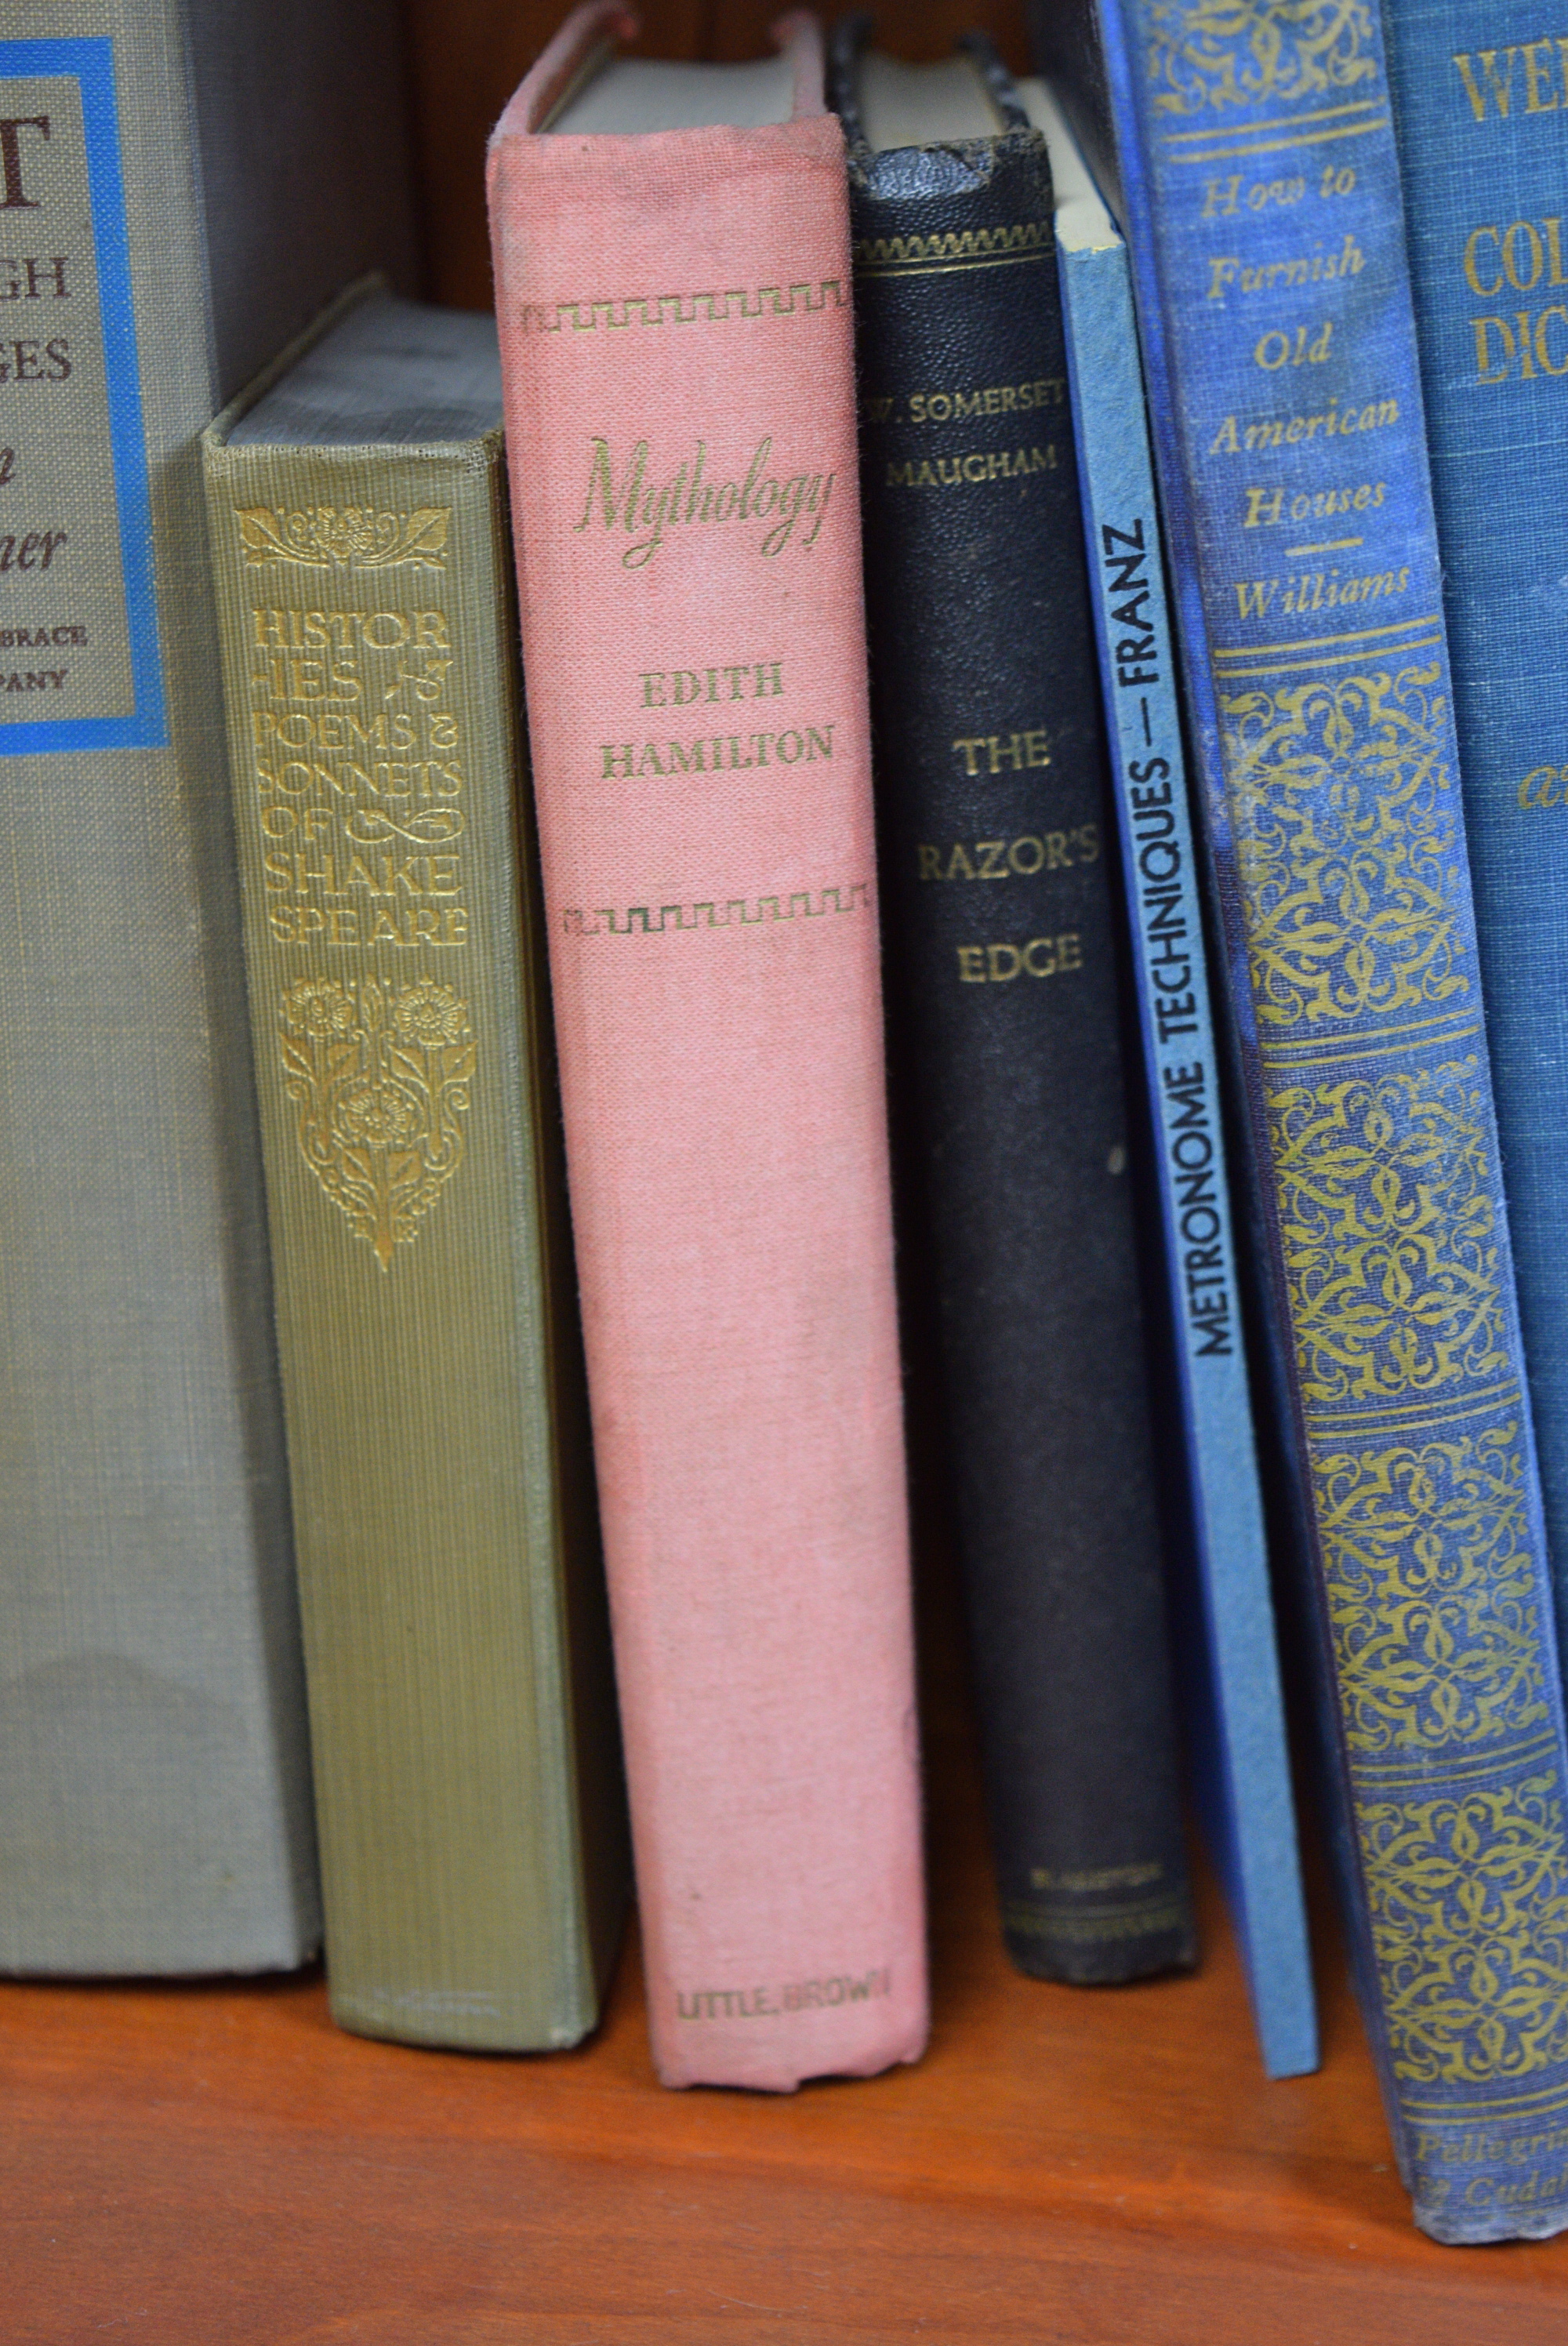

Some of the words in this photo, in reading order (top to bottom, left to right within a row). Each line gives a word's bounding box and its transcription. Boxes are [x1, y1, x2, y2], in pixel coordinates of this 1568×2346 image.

[1201, 172, 1305, 219] How
[1319, 165, 1356, 200] to
[1207, 234, 1367, 300] Furnish
[1254, 321, 1334, 371] Old
[909, 376, 1066, 423] SOMERSET
[1210, 398, 1399, 456] American
[885, 444, 1058, 487] MAUGHAM
[573, 436, 837, 571] Mythology
[1244, 481, 1387, 528] Houses
[1102, 518, 1160, 688] FRANZ
[1234, 565, 1411, 619] Williams
[252, 608, 452, 649] HISTOR
[638, 663, 785, 709] EDITH
[252, 710, 417, 750] POEMS
[428, 711, 459, 749] &
[601, 724, 836, 780] HAMILTON
[953, 730, 1051, 776] THE
[256, 757, 463, 798] SONNETS
[262, 804, 334, 841] OF
[265, 851, 463, 898] SHAKE
[917, 824, 1100, 881] RAZOR'S
[269, 904, 470, 947] SPEARE
[1128, 757, 1199, 1044] TECHNIQUES
[956, 932, 1083, 984] EDGE
[1162, 1061, 1233, 1358] METRONOME
